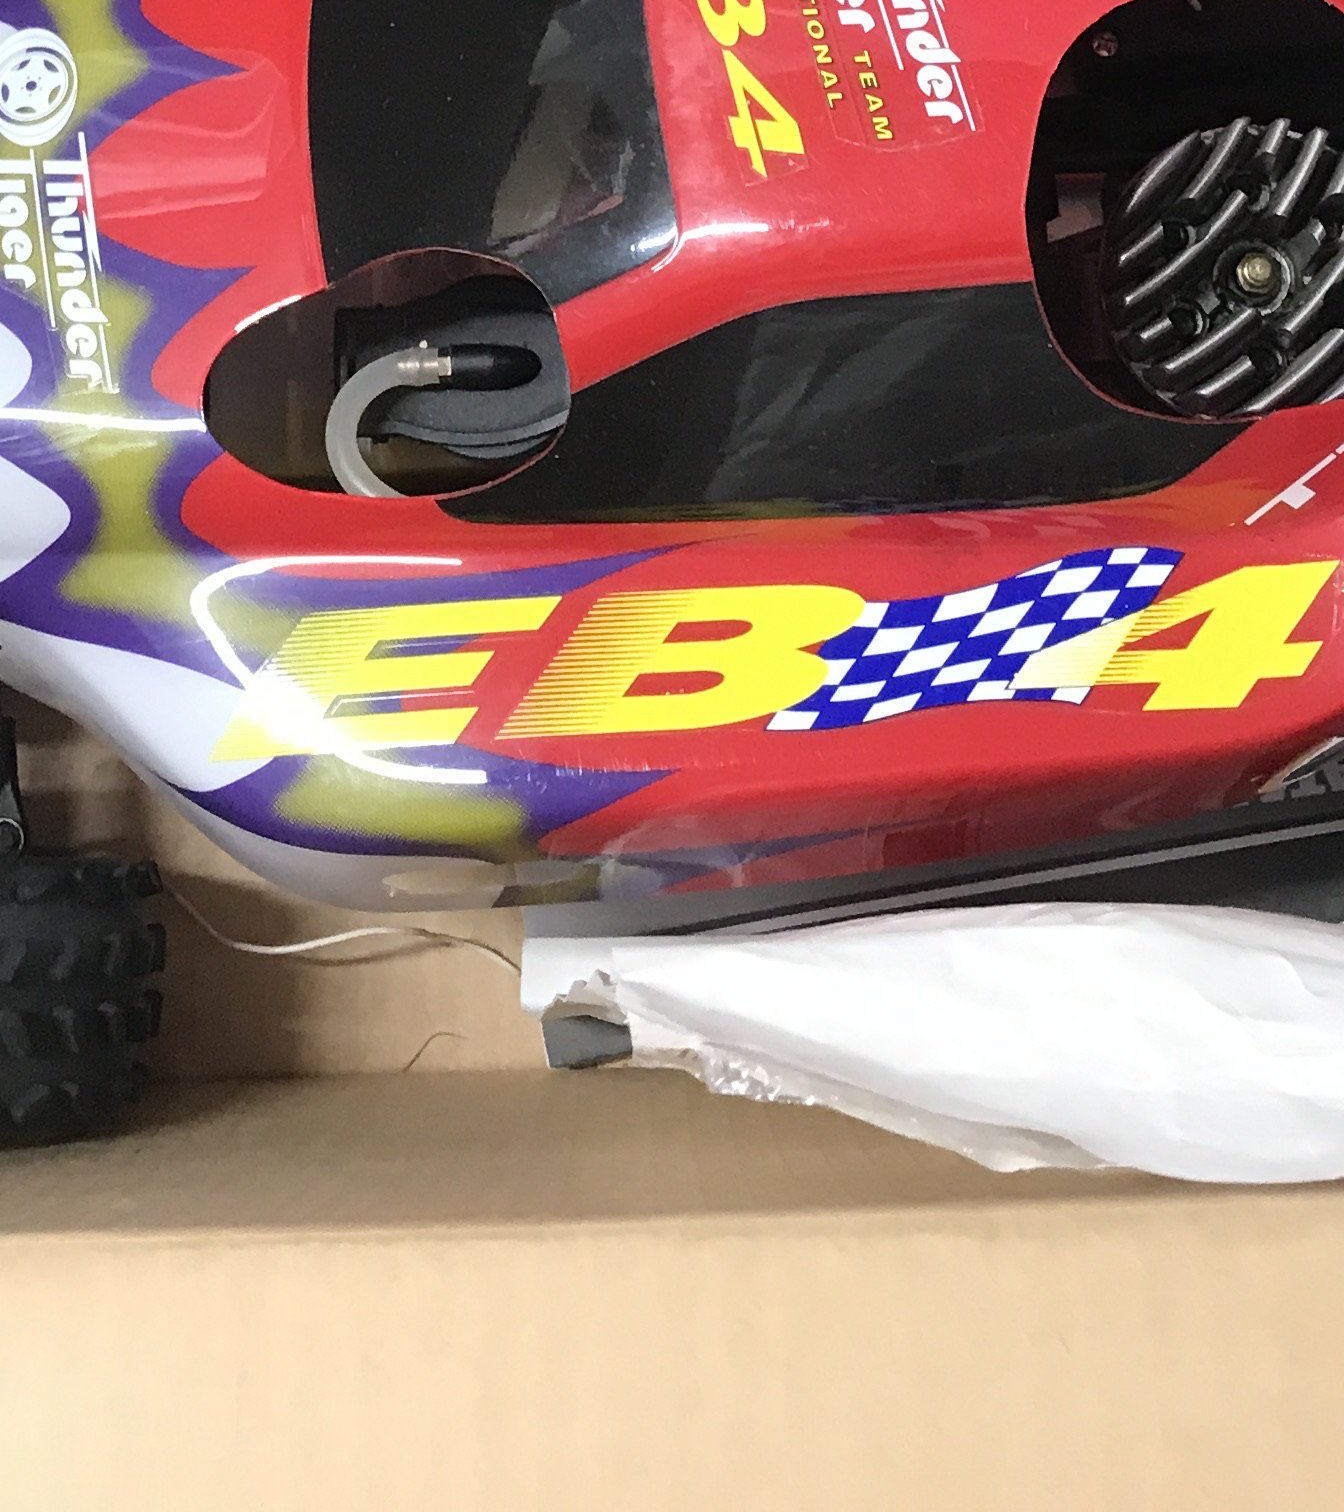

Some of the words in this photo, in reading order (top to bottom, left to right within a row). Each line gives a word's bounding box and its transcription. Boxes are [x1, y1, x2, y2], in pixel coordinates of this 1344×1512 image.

[855, 51, 893, 141] TEAM
[43, 132, 120, 393] Thunder
[213, 560, 1340, 763] EB4
